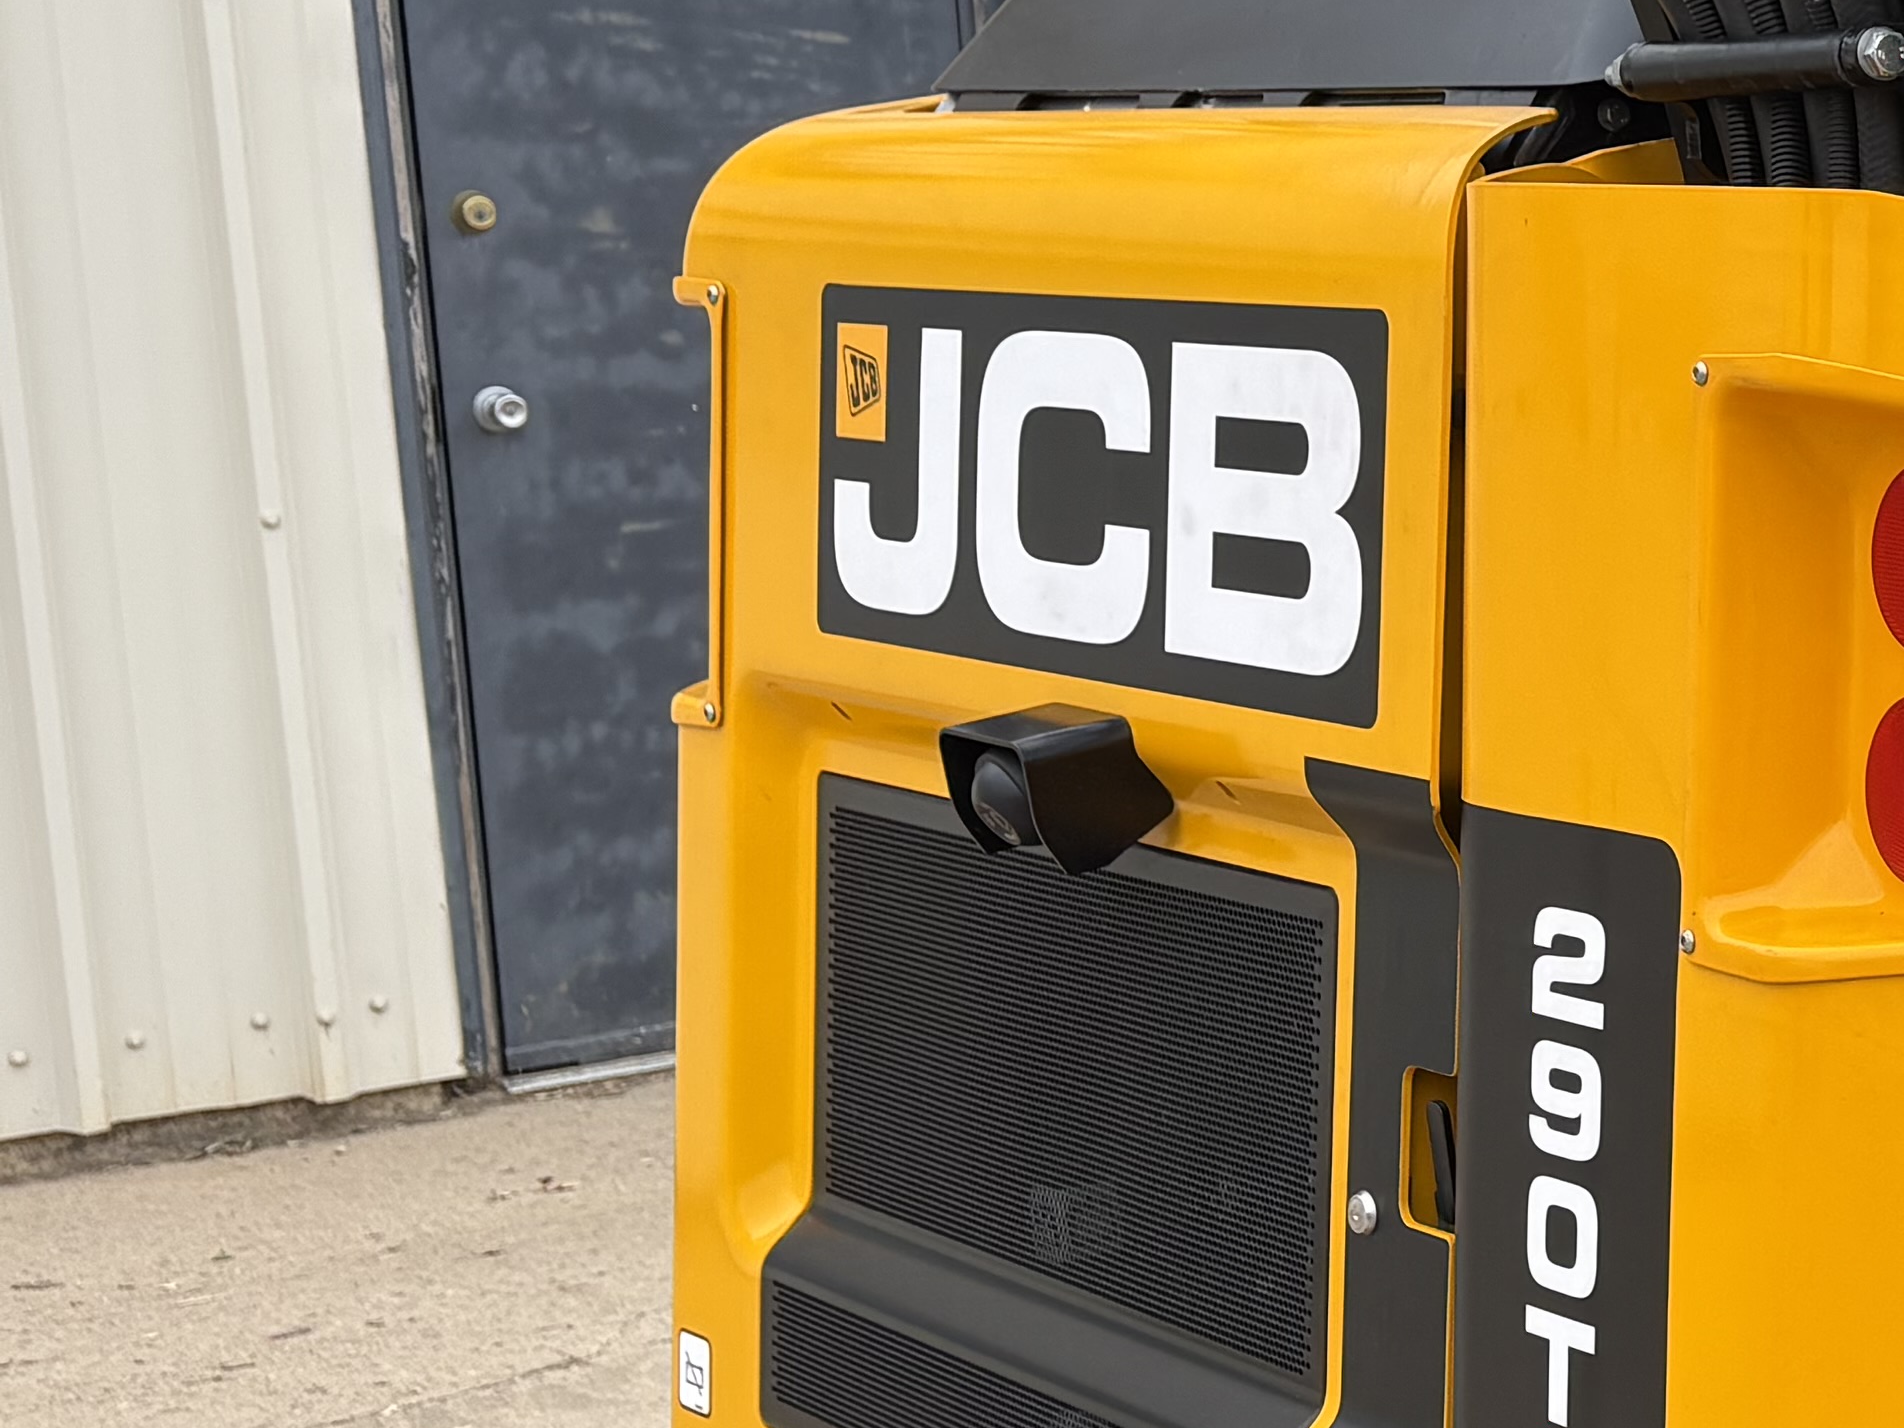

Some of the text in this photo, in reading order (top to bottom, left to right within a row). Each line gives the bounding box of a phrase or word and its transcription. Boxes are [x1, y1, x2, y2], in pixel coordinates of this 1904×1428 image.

[833, 327, 1363, 677] JCB
[850, 353, 877, 408] JCB
[1524, 905, 1606, 1428] 290T
